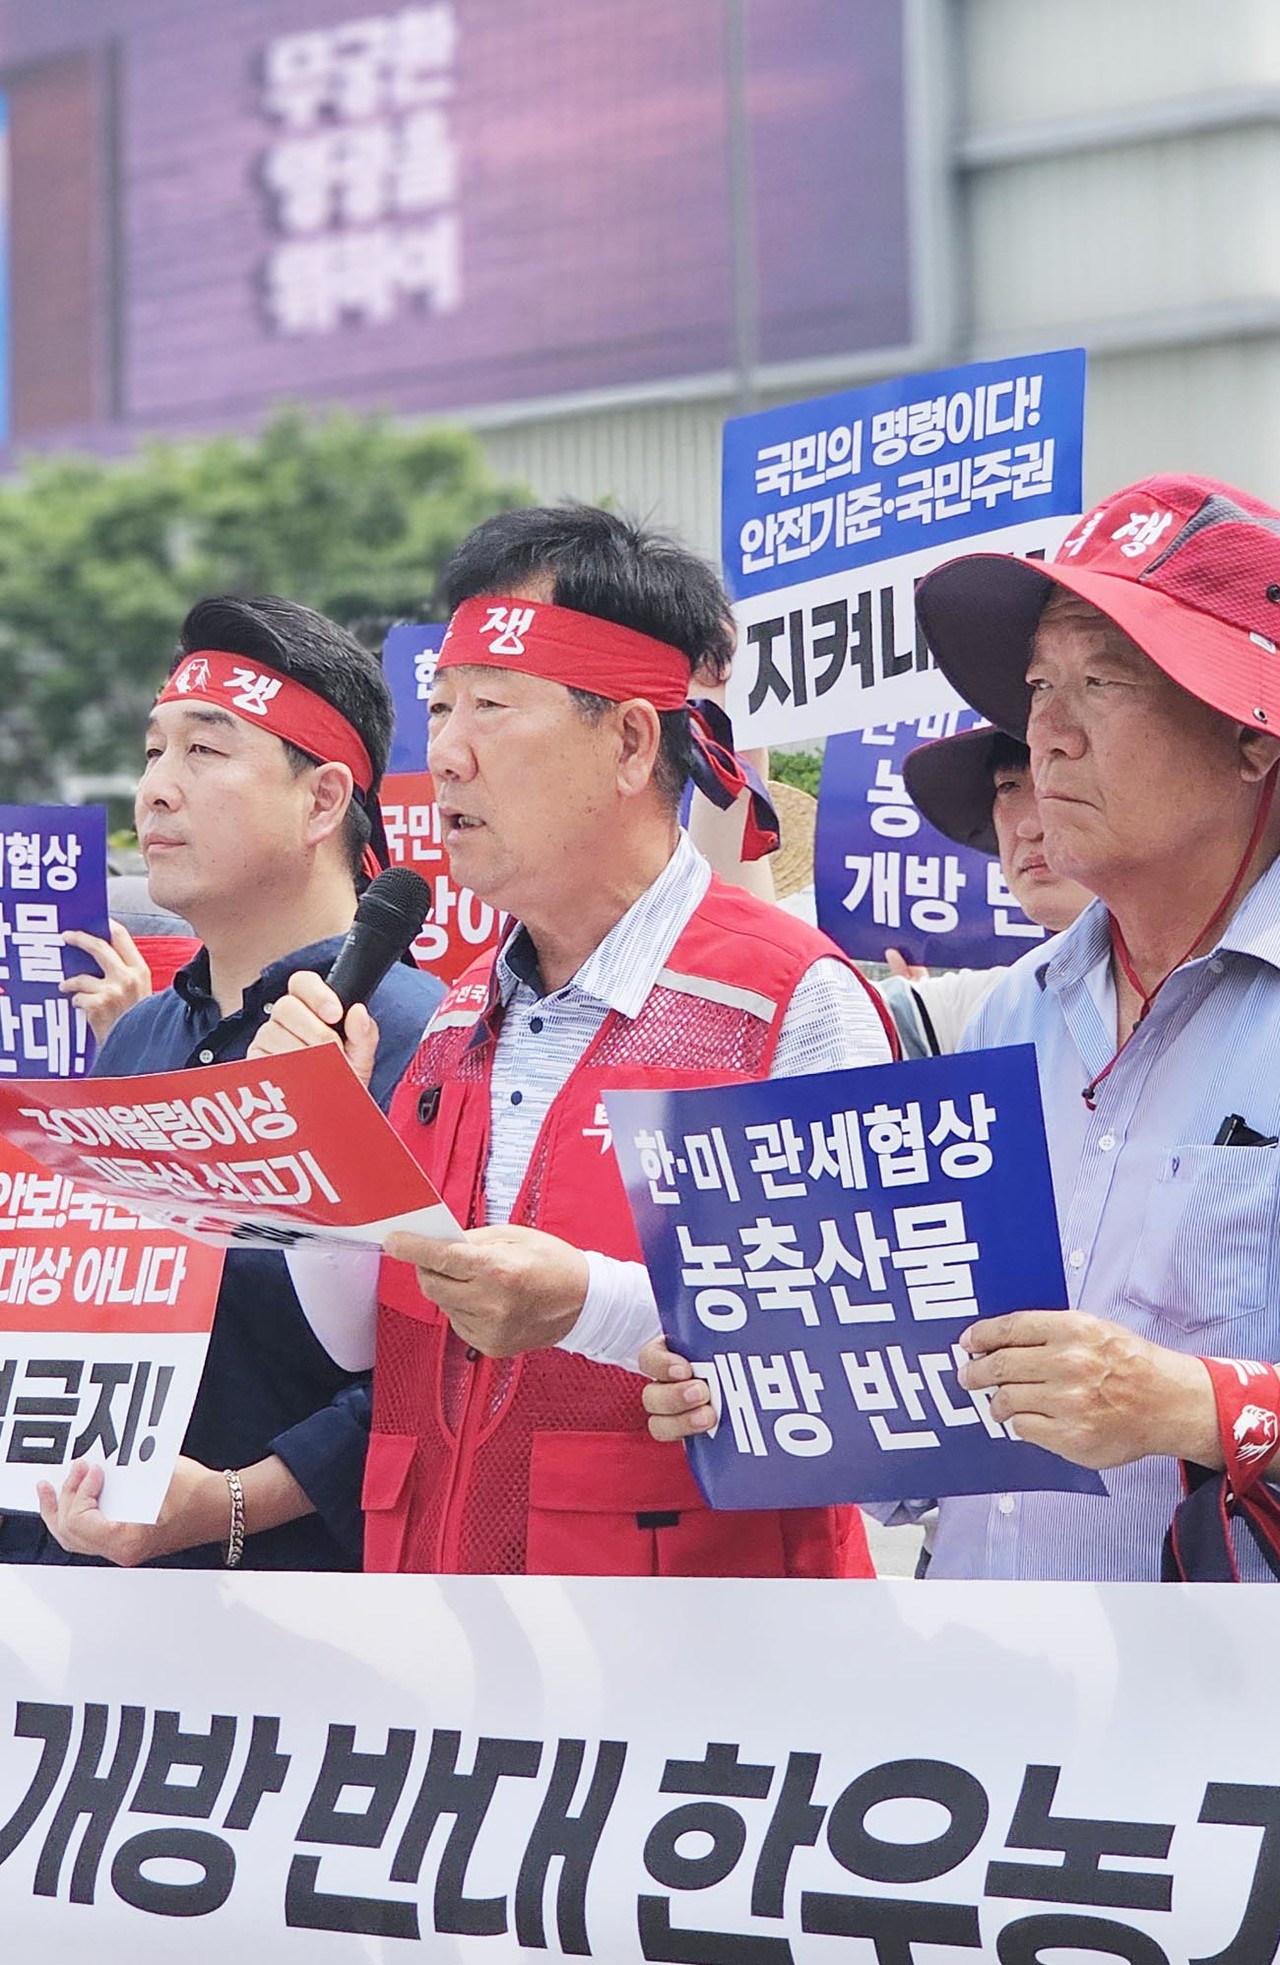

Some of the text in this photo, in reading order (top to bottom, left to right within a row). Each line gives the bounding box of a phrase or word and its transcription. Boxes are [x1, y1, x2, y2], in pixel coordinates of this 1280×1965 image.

[755, 374, 1043, 498] 국민의 명령이다!
[479, 606, 536, 655] 쟁
[223, 666, 283, 716] 쟁
[0, 832, 82, 891] 협상
[842, 851, 967, 934] 개방
[18, 1080, 298, 1151] 30개월령이상
[633, 1093, 997, 1205] 한·미 관세협상
[199, 1150, 342, 1206] 쇠고기
[73, 1246, 188, 1306] 아니다
[675, 1200, 981, 1333] 농축산물
[691, 1350, 834, 1458] 개방
[0, 1701, 292, 1917] 개방
[285, 1723, 628, 1957] 반대
